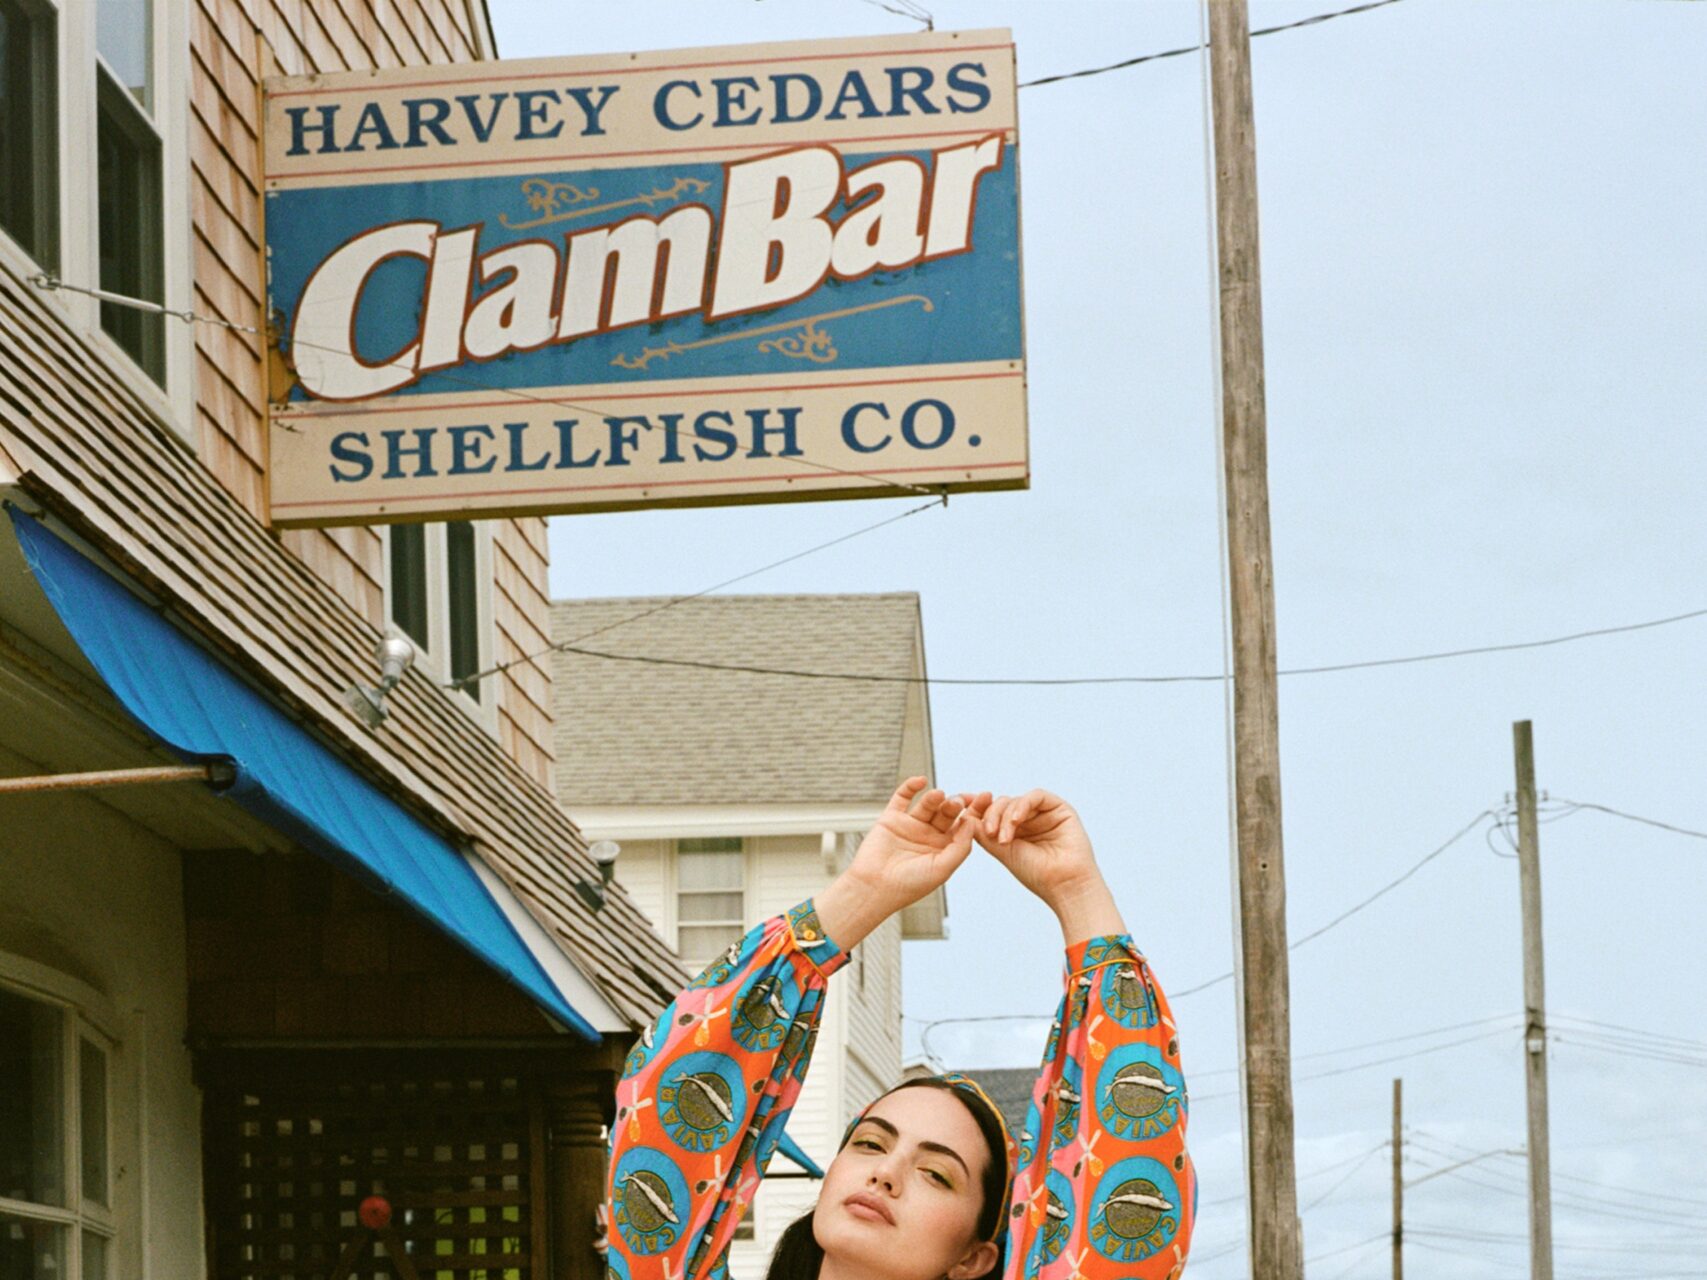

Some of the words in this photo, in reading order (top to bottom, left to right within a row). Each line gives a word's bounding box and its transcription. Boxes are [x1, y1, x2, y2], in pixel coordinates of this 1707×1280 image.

[284, 85, 621, 157] HARVEY
[653, 62, 992, 131] CEDARS
[329, 407, 804, 483] SHELLFISH
[840, 399, 982, 453] CO.
[661, 1087, 730, 1150] CAVIAR
[1090, 1215, 1177, 1260] CAVIAR
